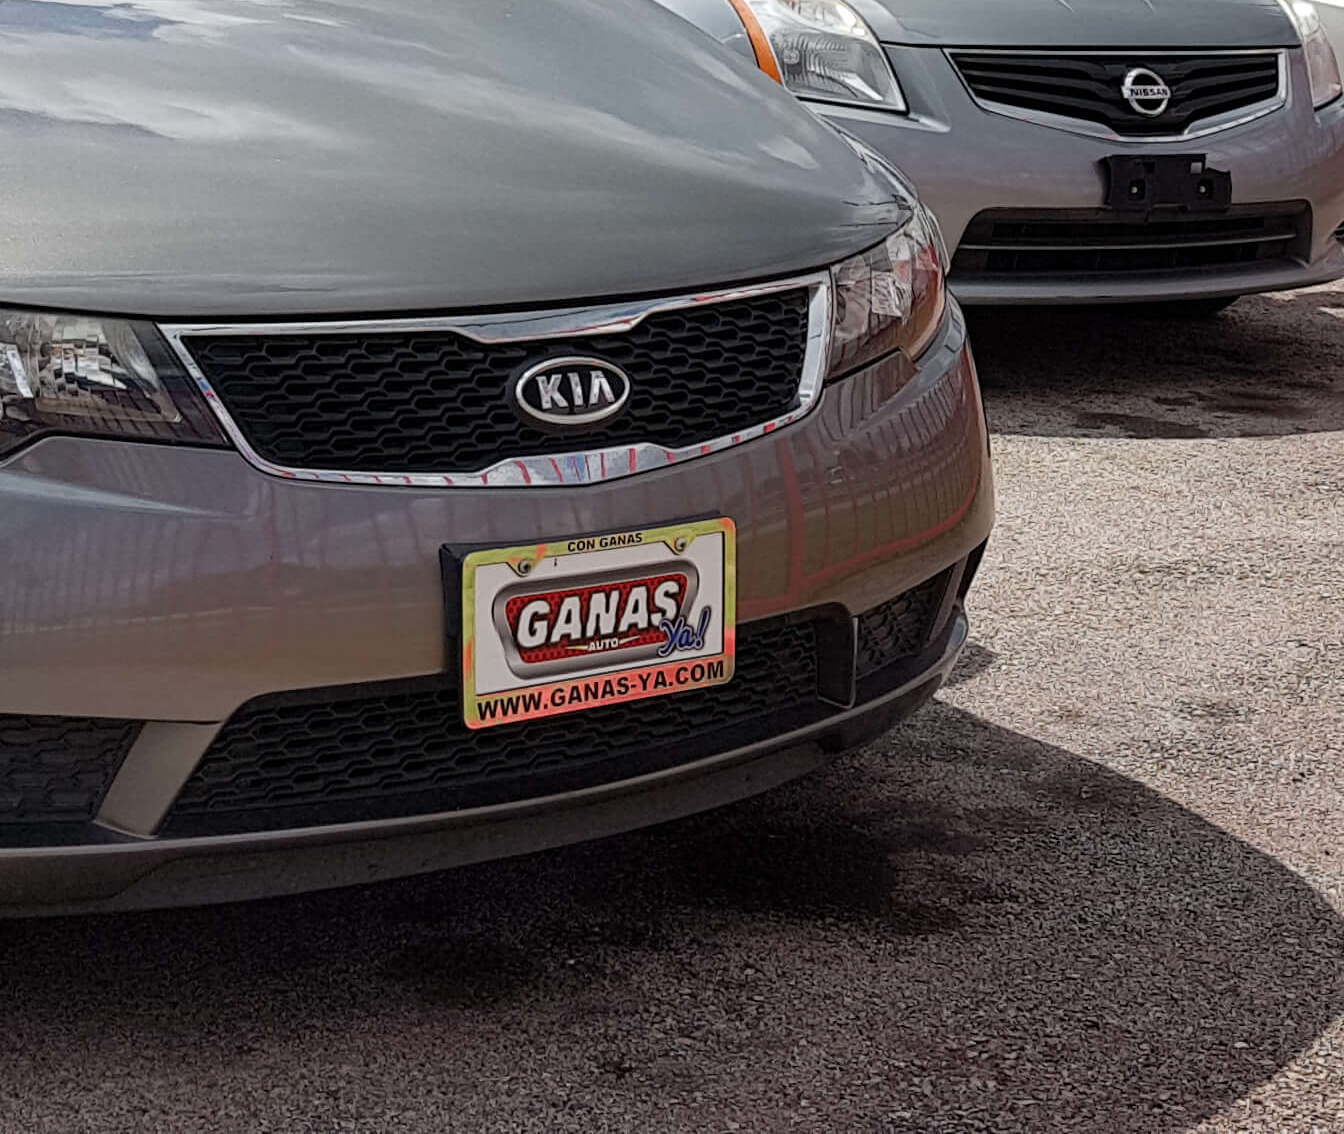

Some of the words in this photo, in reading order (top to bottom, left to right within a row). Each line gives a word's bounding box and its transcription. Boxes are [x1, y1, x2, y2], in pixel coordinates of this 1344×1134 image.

[1130, 88, 1168, 97] NISSAN
[536, 371, 616, 411] KIA
[567, 539, 596, 553] CON
[599, 532, 643, 548] GANAS
[517, 580, 680, 648] GANAS
[657, 605, 712, 657] Ya!
[588, 637, 619, 651] AUTO
[477, 659, 724, 720] WWW.GANAS-YA.COM
